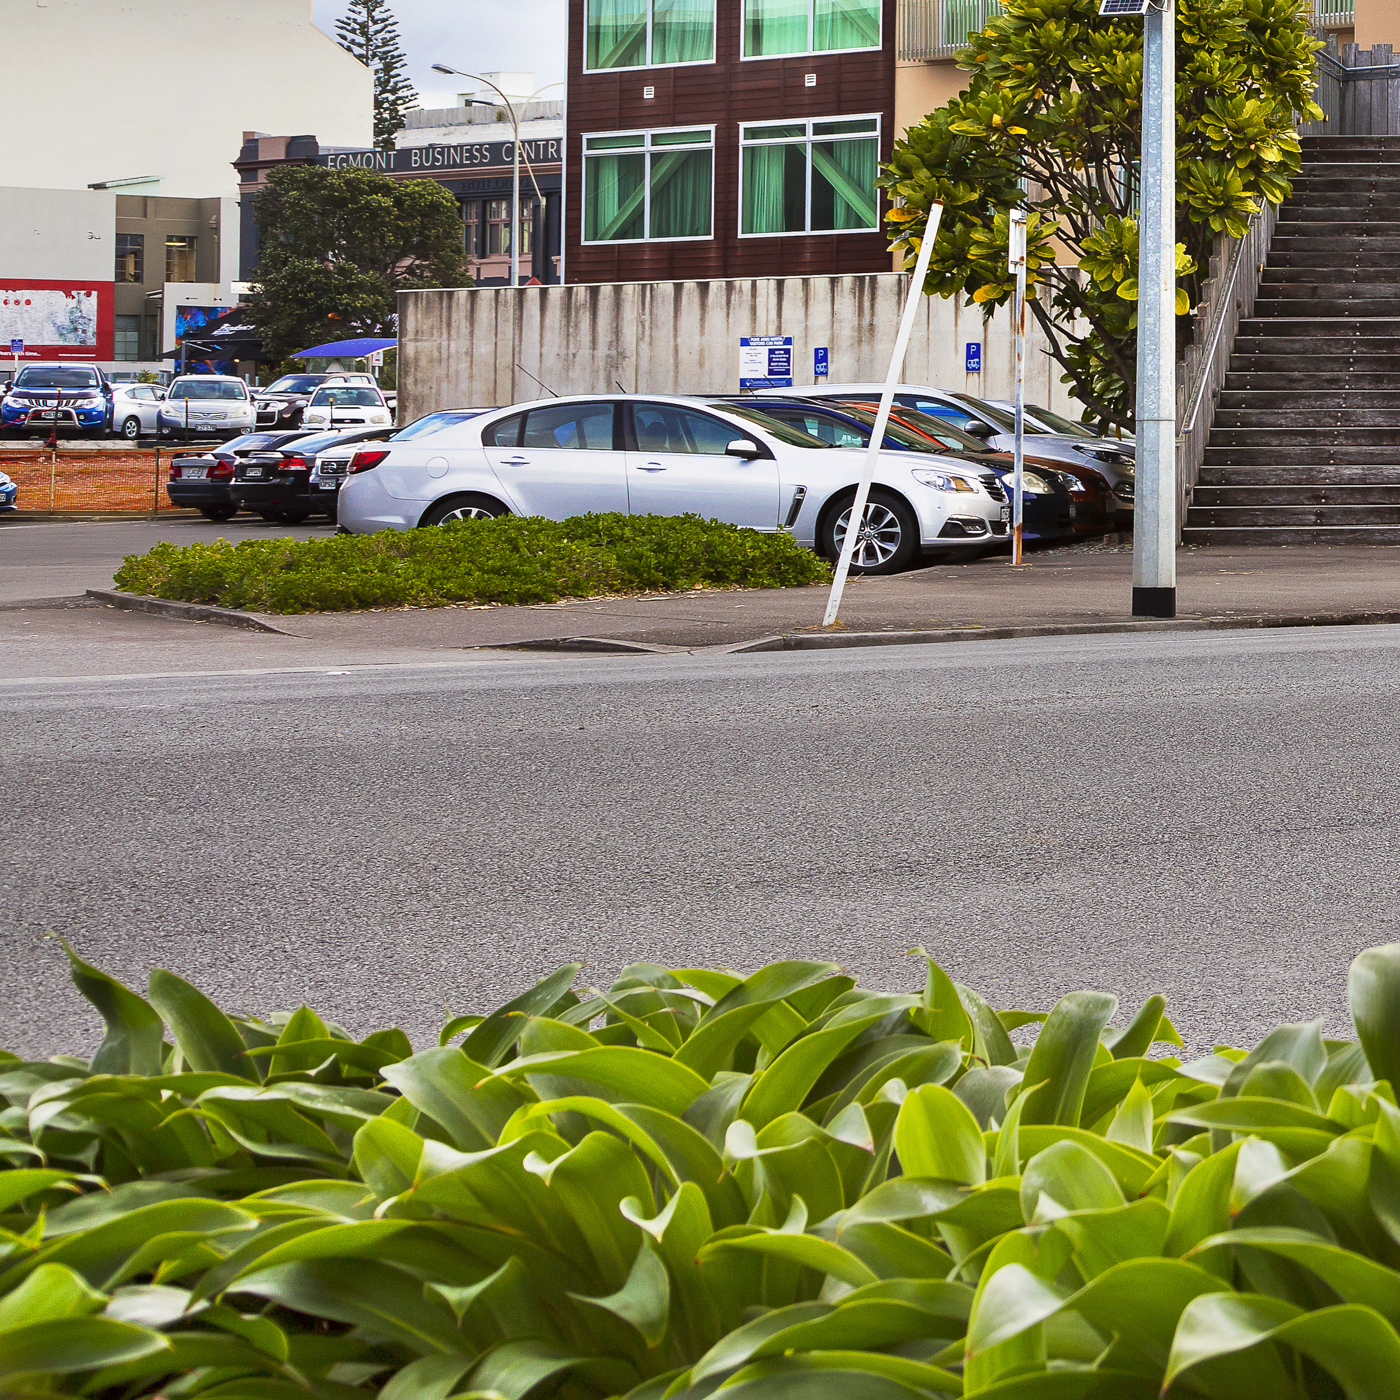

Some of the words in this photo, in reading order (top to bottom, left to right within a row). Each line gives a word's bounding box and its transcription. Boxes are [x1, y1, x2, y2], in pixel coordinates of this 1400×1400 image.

[327, 151, 397, 170] EGMONT
[412, 144, 490, 167] BUSINESS
[818, 350, 824, 360] P
[970, 345, 976, 355] P
